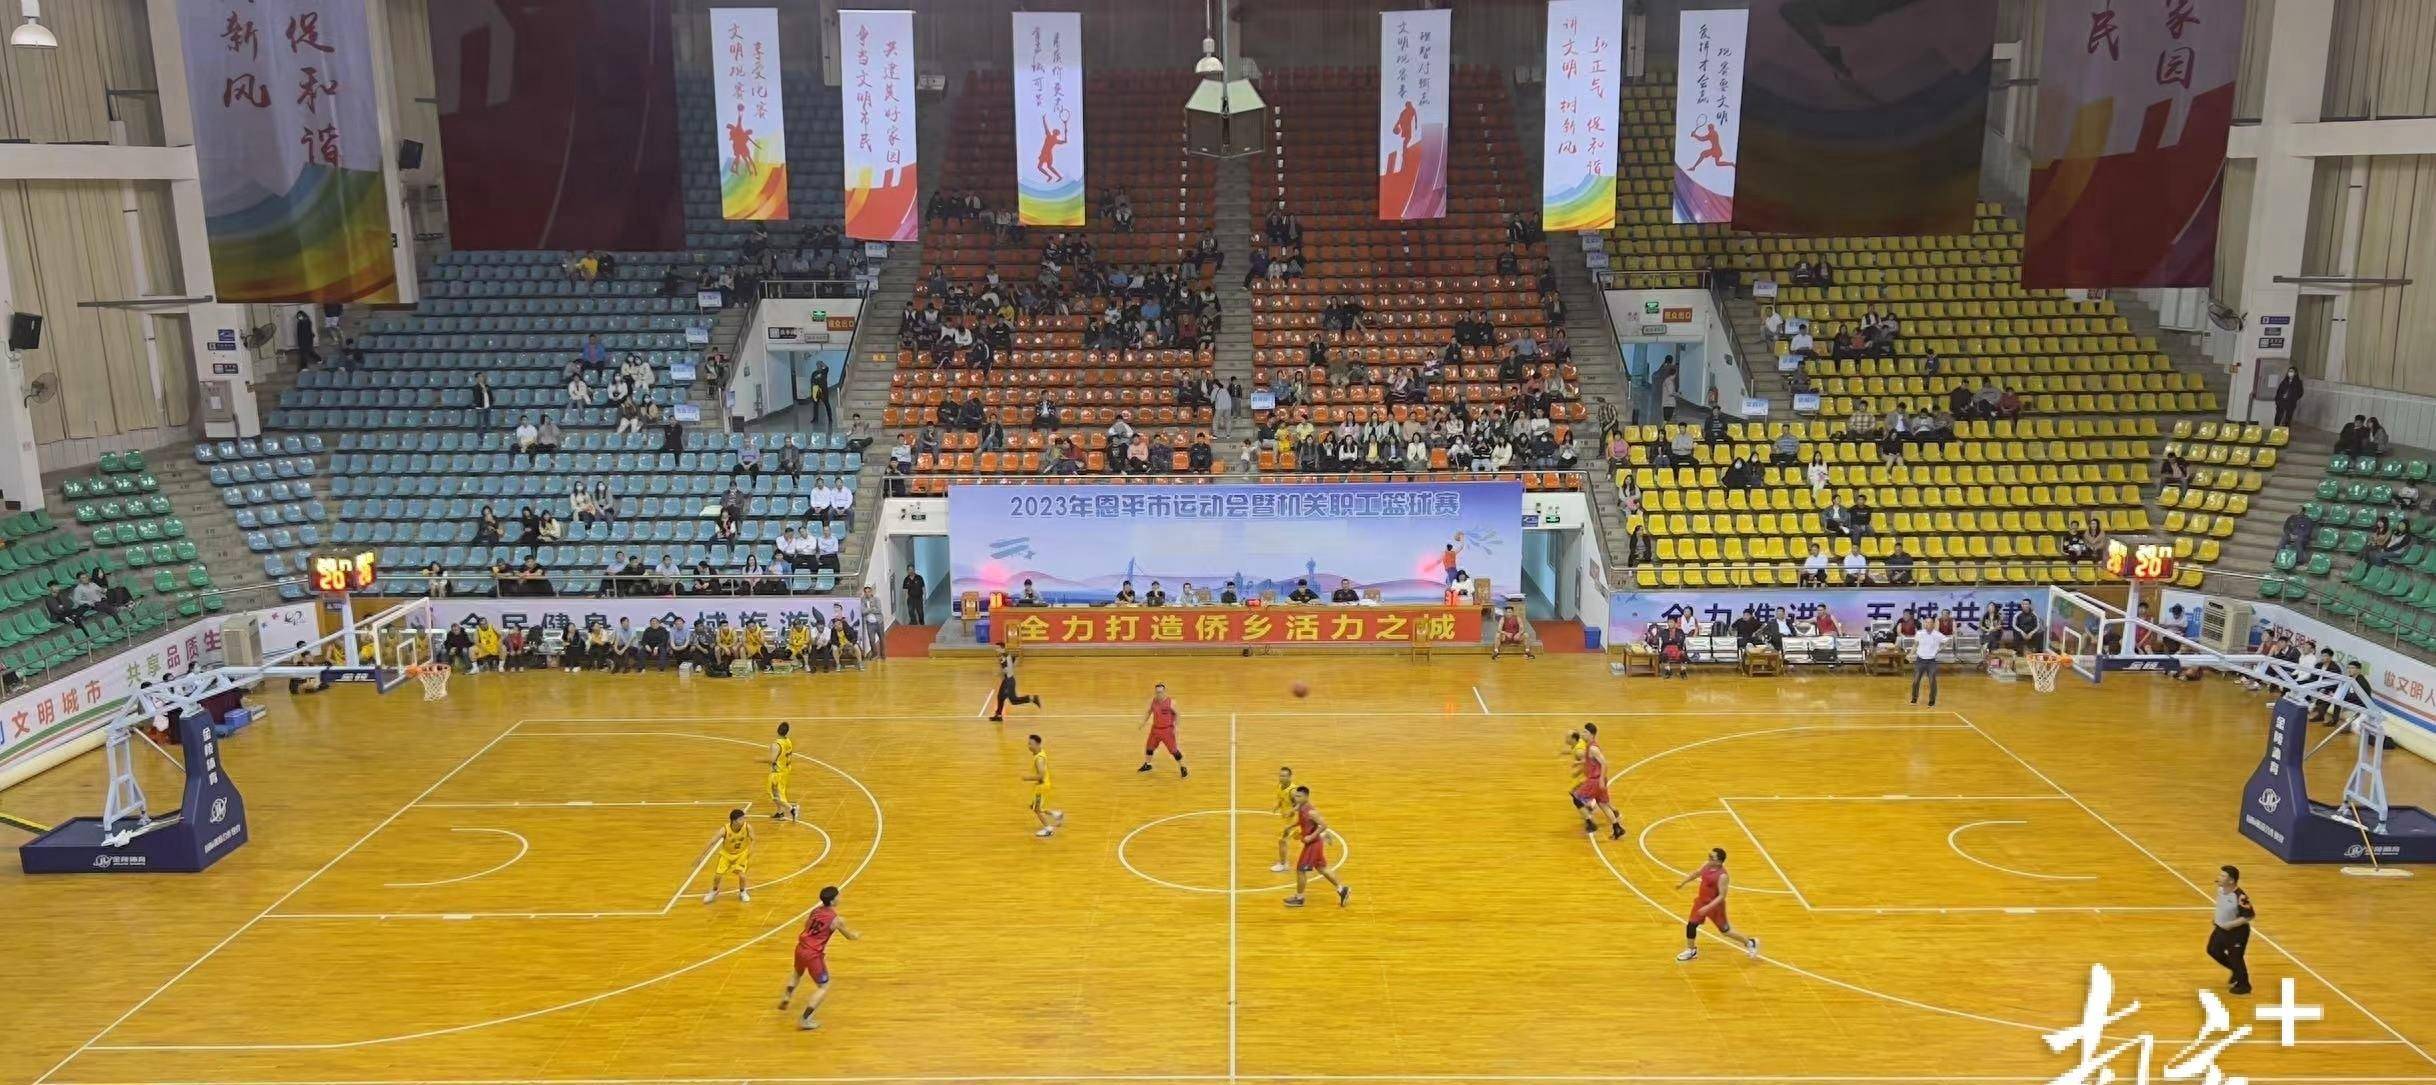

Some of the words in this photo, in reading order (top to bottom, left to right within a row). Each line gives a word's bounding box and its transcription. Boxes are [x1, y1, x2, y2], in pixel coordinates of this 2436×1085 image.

[286, 11, 340, 168] 促和谐
[856, 24, 873, 153] 争当文明市民
[882, 41, 901, 165] 共建美好家园
[1010, 492, 1462, 520] 2023年恩平市运动会暨机关职工篮球赛
[1020, 614, 1457, 642] 全力打造侨乡活力之城
[11, 680, 101, 738] 文明城市
